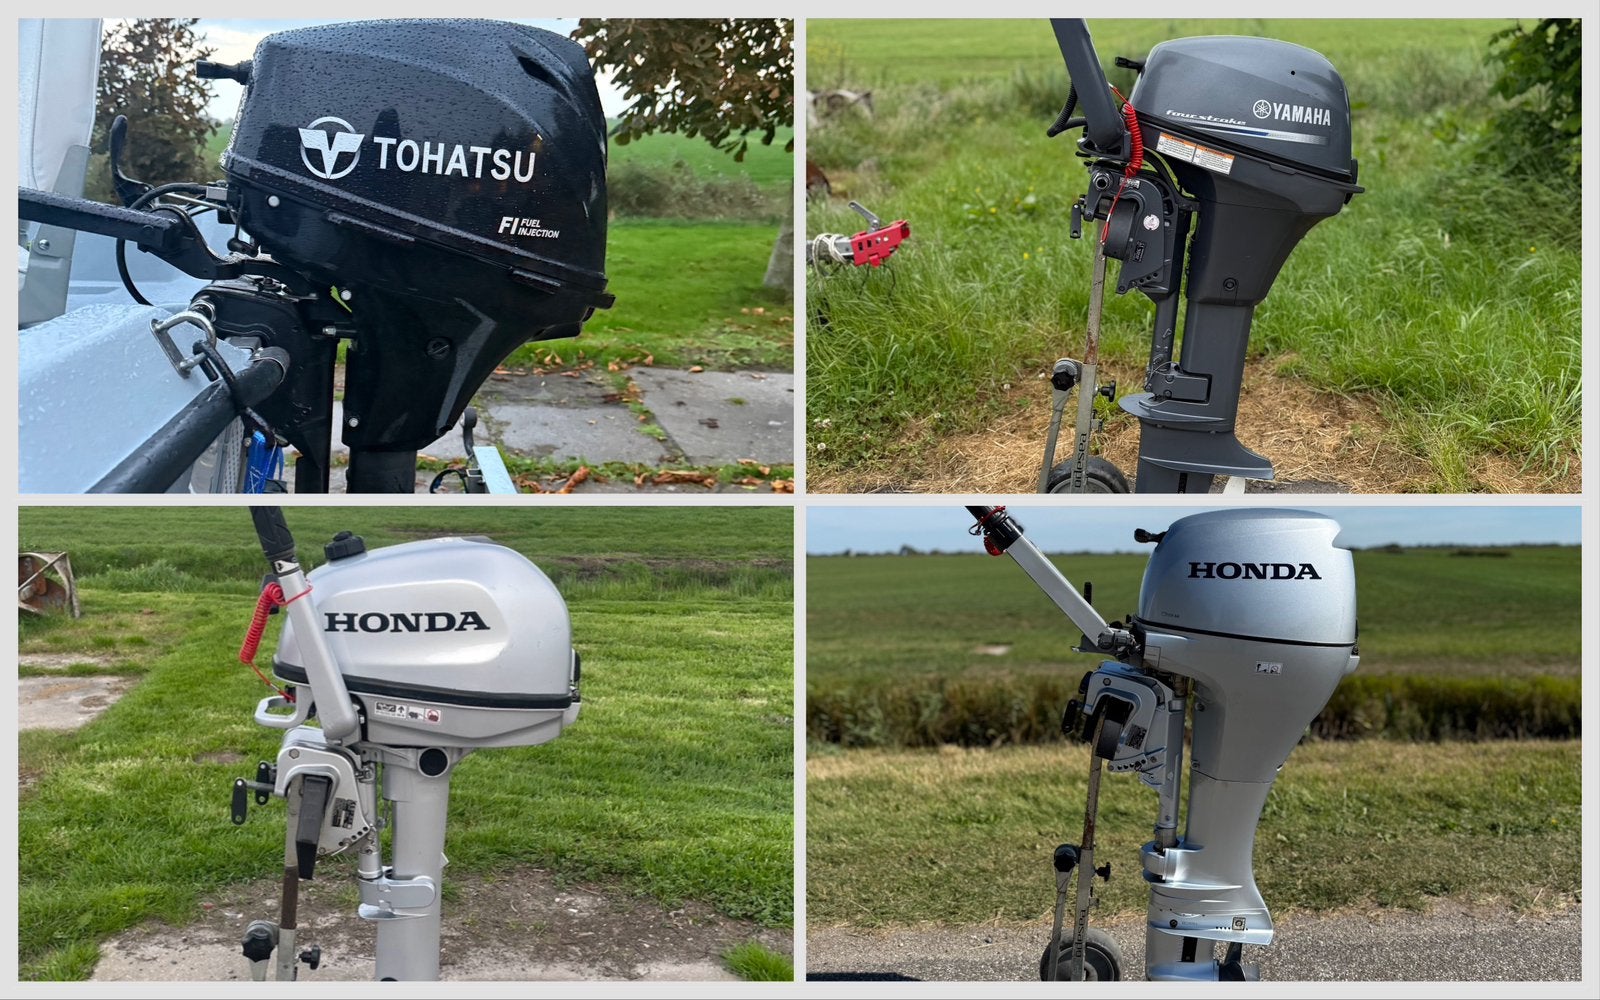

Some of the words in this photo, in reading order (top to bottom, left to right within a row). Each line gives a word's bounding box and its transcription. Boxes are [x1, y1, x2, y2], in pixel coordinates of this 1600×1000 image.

[1273, 102, 1331, 126] YAMAHA
[373, 136, 536, 183] TOHATSU
[497, 216, 520, 235] FI
[520, 218, 541, 228] FUEL
[517, 227, 560, 239] INJECTION
[1187, 561, 1322, 580] HONDA
[324, 611, 491, 633] HONDA
